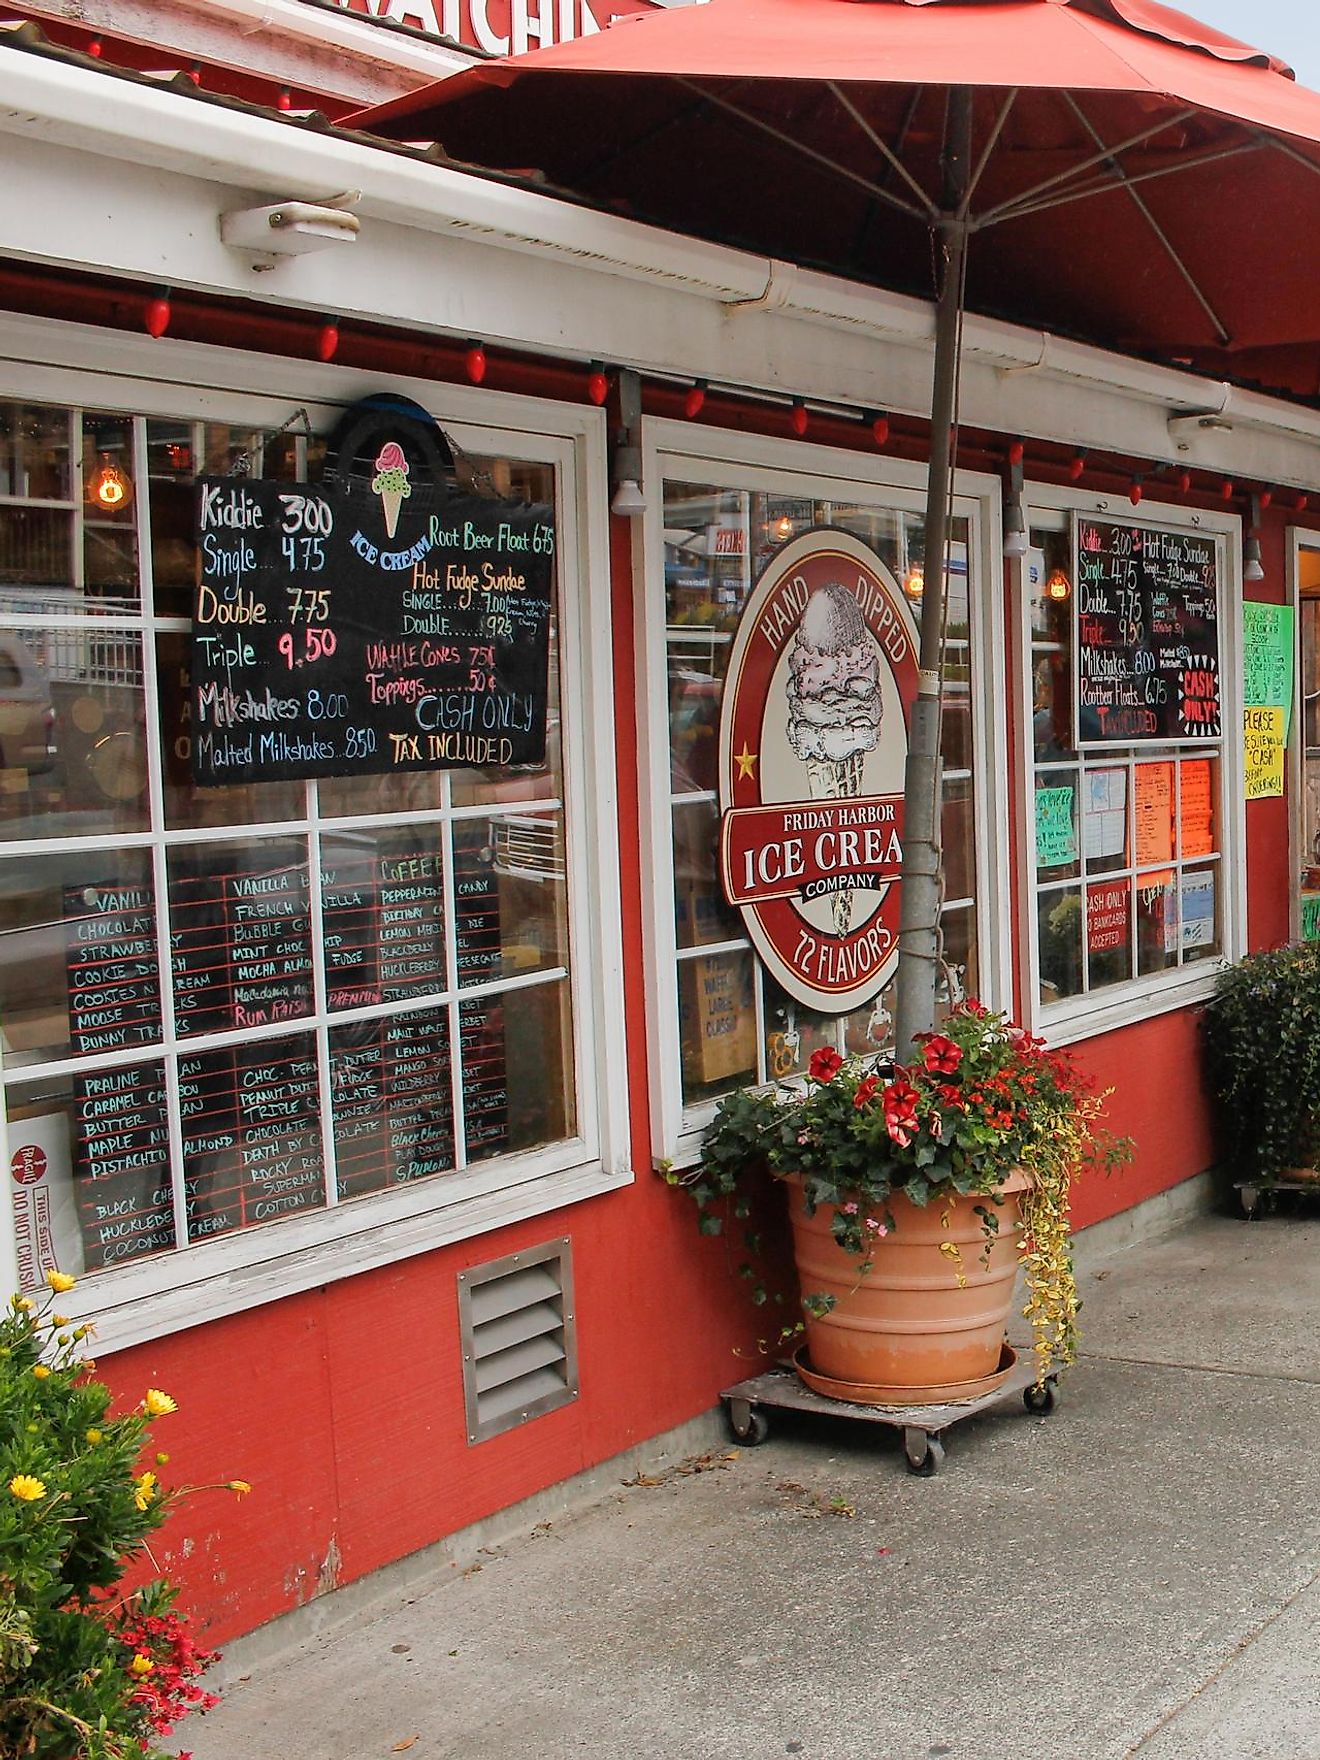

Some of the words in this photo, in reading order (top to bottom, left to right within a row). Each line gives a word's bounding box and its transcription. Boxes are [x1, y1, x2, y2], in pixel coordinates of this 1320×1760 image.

[200, 483, 264, 531] Kiddie
[429, 515, 460, 547] Root
[463, 521, 494, 550] Beer
[497, 523, 530, 553] Float
[1143, 530, 1160, 559] Hot
[1161, 534, 1182, 565] Fudge
[1183, 538, 1209, 564] Sundae
[350, 530, 377, 565] ICE
[380, 536, 432, 571] CREAM
[204, 534, 257, 601] Single
[1079, 551, 1104, 587] Single
[413, 561, 440, 591] Hot
[446, 564, 480, 609] Fudge
[480, 562, 526, 592] Sundae
[198, 585, 267, 625] Double
[1080, 583, 1108, 614] Double
[1116, 588, 1143, 622] 7.75
[760, 575, 809, 650] HAND
[855, 575, 907, 663] DIPPED
[196, 632, 257, 690] Triple
[278, 628, 337, 671] 9.50
[1081, 646, 1127, 677] Milkshakes
[366, 673, 425, 705] Toppings
[1184, 671, 1214, 698] CASH
[198, 681, 300, 728] Milkshakes
[307, 688, 349, 720] 8.00
[415, 694, 475, 732] CASH
[482, 693, 534, 732] ONLY
[1184, 699, 1217, 723] ONLY!
[1244, 709, 1274, 732] PLEASE
[198, 731, 252, 774] Malted
[260, 730, 334, 764] Milkshakes
[388, 732, 423, 764] TAX
[429, 732, 513, 765] INCLUDED
[783, 809, 835, 832] FRIDAY
[838, 804, 896, 825] HARBOR
[743, 838, 806, 890] ICE
[815, 828, 904, 871] CREA
[233, 876, 289, 897] VANILLA
[458, 880, 489, 895] CANDY
[805, 873, 876, 898] COMPANY
[1107, 890, 1127, 909] ONLY
[235, 901, 294, 921] FRENCH
[301, 892, 362, 913] VNILLA
[381, 907, 424, 924] BIRTHDAY
[78, 916, 157, 940] CHOCOLAT
[233, 921, 282, 943] BUBBLE
[380, 928, 412, 941] LEMON
[1094, 911, 1127, 931] BANKCARDS
[80, 934, 183, 962] STRAWBEY
[232, 945, 269, 961] MINT
[276, 940, 306, 955] CHOC
[793, 929, 816, 974] 72
[817, 916, 892, 983] FLAVORS
[1090, 931, 1120, 949] ACCEPTED
[75, 965, 125, 987] COOKIE
[238, 962, 277, 980] MOCHA
[332, 950, 363, 966] FUDGE
[74, 989, 137, 1011] COOKIES
[172, 974, 210, 991] REAM
[78, 1009, 122, 1029] MOOSE
[136, 996, 198, 1015] TRKS
[235, 1005, 267, 1027] RUM
[79, 1029, 125, 1052] BUNNY
[133, 1020, 190, 1041] TRAKS
[345, 1050, 383, 1068] BUTTER
[396, 1043, 431, 1058] LEMON
[395, 1061, 427, 1077] MANGO
[85, 1071, 141, 1097] PRALINE
[240, 1087, 285, 1107] PEANUT
[341, 1070, 373, 1086] FUDGE
[83, 1094, 141, 1119] CARAMEL
[243, 1100, 300, 1123] TRIPLE
[84, 1114, 147, 1138] BUTTER
[246, 1118, 308, 1144] CHOCOLATE
[88, 1134, 134, 1159] MAPLE
[91, 1149, 167, 1180] PISTACHIO
[184, 1135, 234, 1157] ALMOND
[242, 1141, 280, 1165] DEATH
[288, 1138, 303, 1153] BY
[20, 1146, 38, 1185] FRAGILE
[252, 1157, 293, 1182] ROCKY
[13, 1190, 29, 1210] DO
[36, 1195, 47, 1223] THIS
[96, 1197, 137, 1220] BLACK
[152, 1181, 200, 1206] CHEY
[255, 1194, 306, 1219] COTTON
[14, 1216, 32, 1241] NOT
[39, 1229, 50, 1256] SIDE
[103, 1231, 176, 1263] COCONUT
[188, 1216, 232, 1238] CREAM
[17, 1244, 37, 1294] CRUSH
